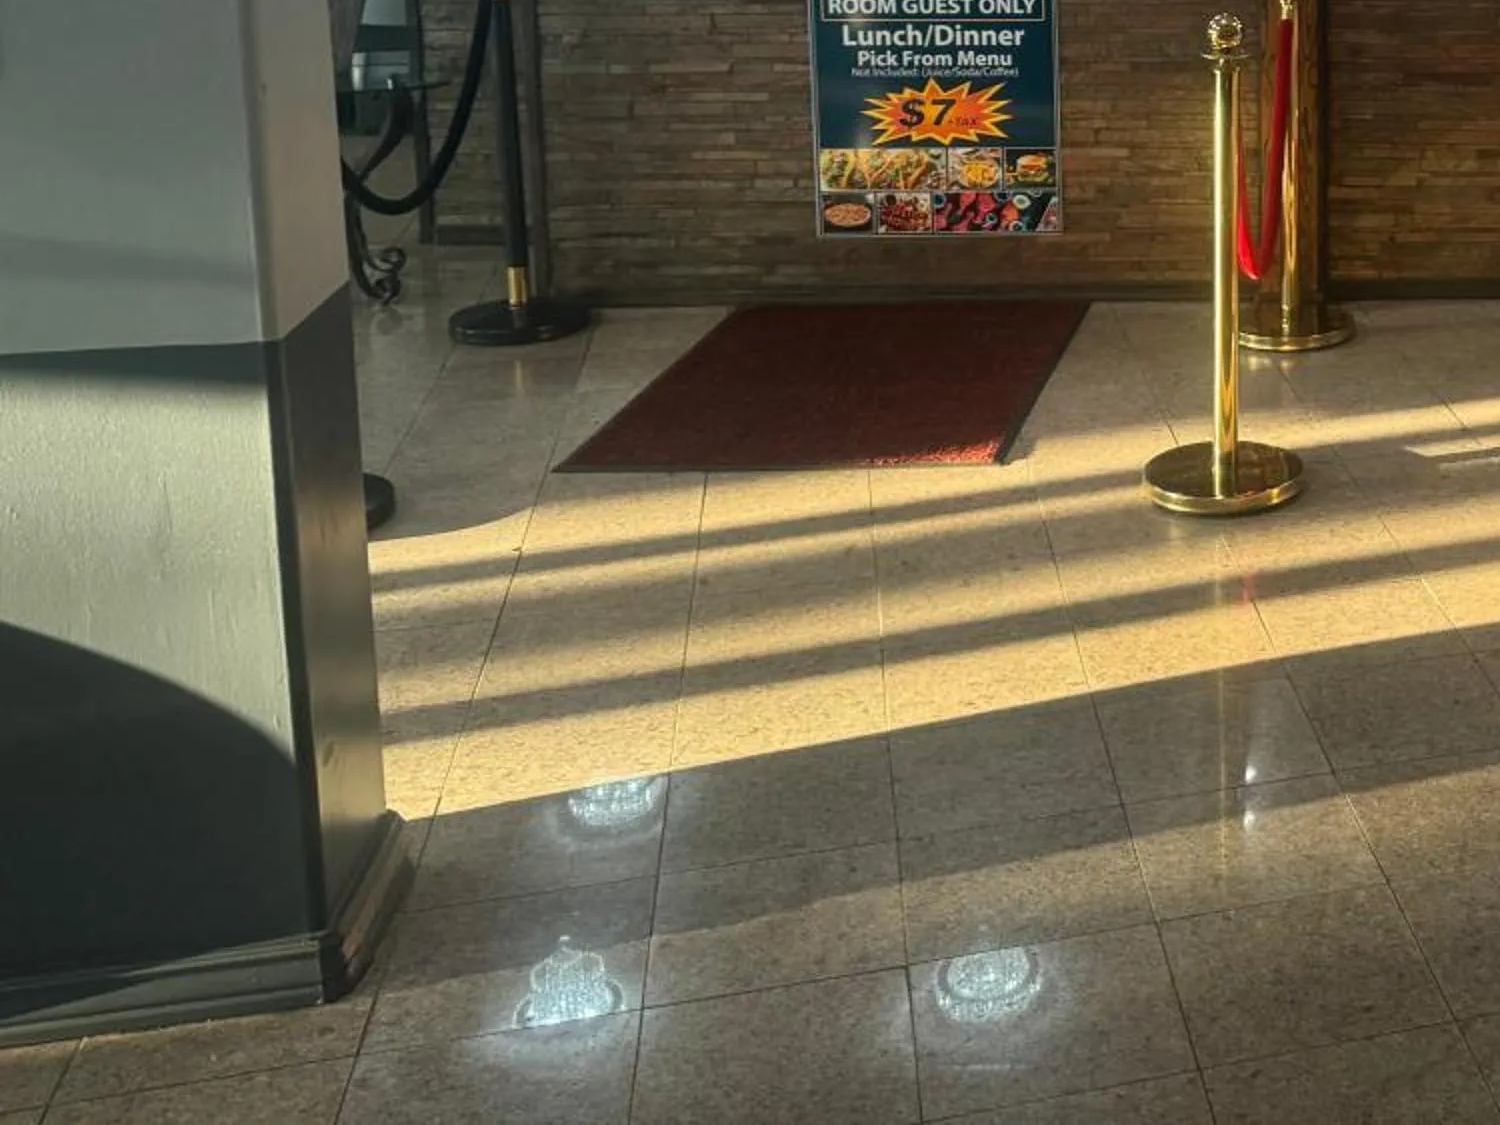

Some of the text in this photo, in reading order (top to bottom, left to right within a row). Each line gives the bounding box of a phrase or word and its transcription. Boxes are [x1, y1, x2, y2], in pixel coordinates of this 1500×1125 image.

[842, 24, 1025, 47] Lunch/Dinner
[857, 50, 1013, 66] Pick From Menu
[899, 97, 957, 128] $7
